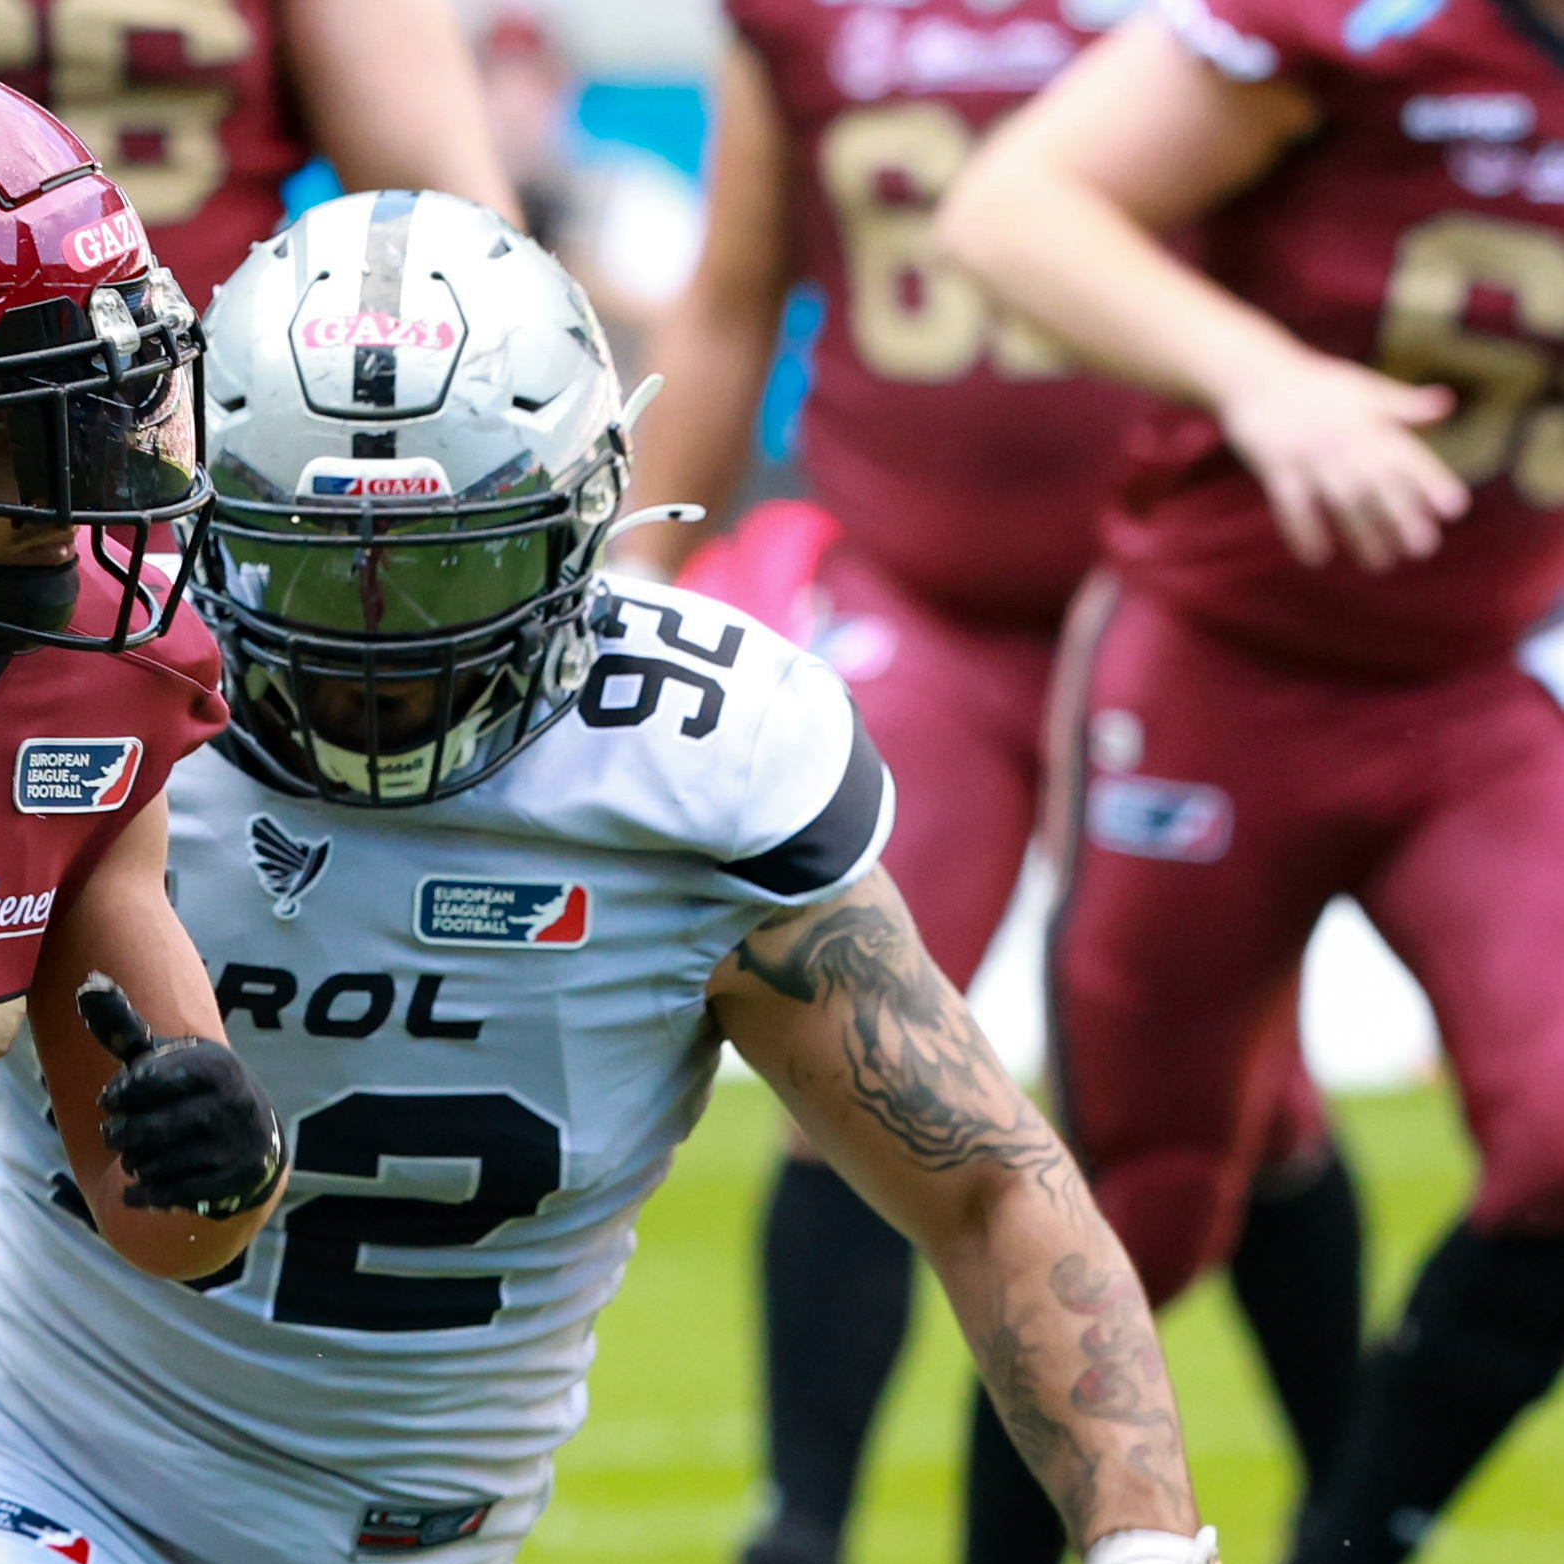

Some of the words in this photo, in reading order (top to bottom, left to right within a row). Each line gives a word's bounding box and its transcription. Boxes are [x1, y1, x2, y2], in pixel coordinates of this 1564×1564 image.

[374, 479, 433, 496] GAZI
[578, 595, 745, 739] 92
[29, 753, 90, 767] EUROPEAN
[28, 769, 70, 782] LEAGUE
[27, 784, 82, 798] FOOTBALL
[434, 886, 515, 904] EUROPEAN
[433, 902, 491, 918] LEAGUE
[432, 917, 509, 935] FOOTBALL
[203, 959, 483, 1040] ROL
